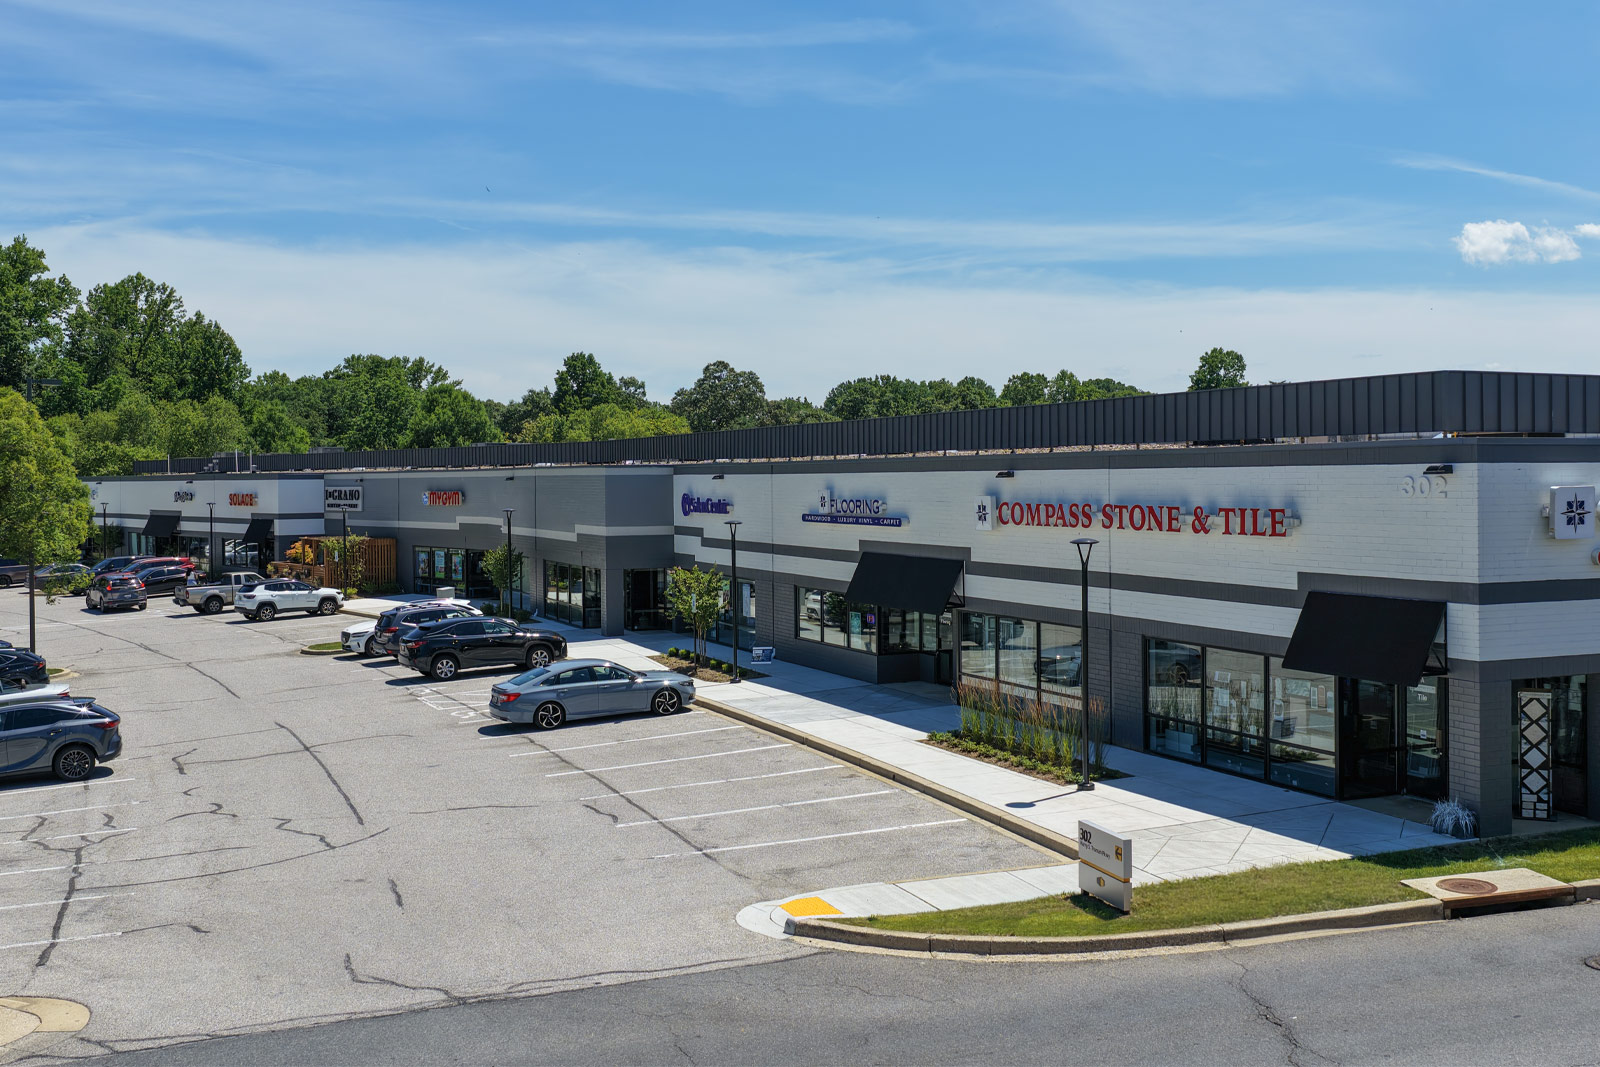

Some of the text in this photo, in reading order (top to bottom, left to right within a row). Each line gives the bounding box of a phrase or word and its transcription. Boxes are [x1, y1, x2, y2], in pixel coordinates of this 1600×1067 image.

[1402, 475, 1447, 498] 302
[229, 493, 254, 506] SOLACE
[830, 499, 880, 514] FLOORING
[998, 502, 1288, 537] COMPASS STONE & TILE
[1080, 828, 1092, 844] 302
